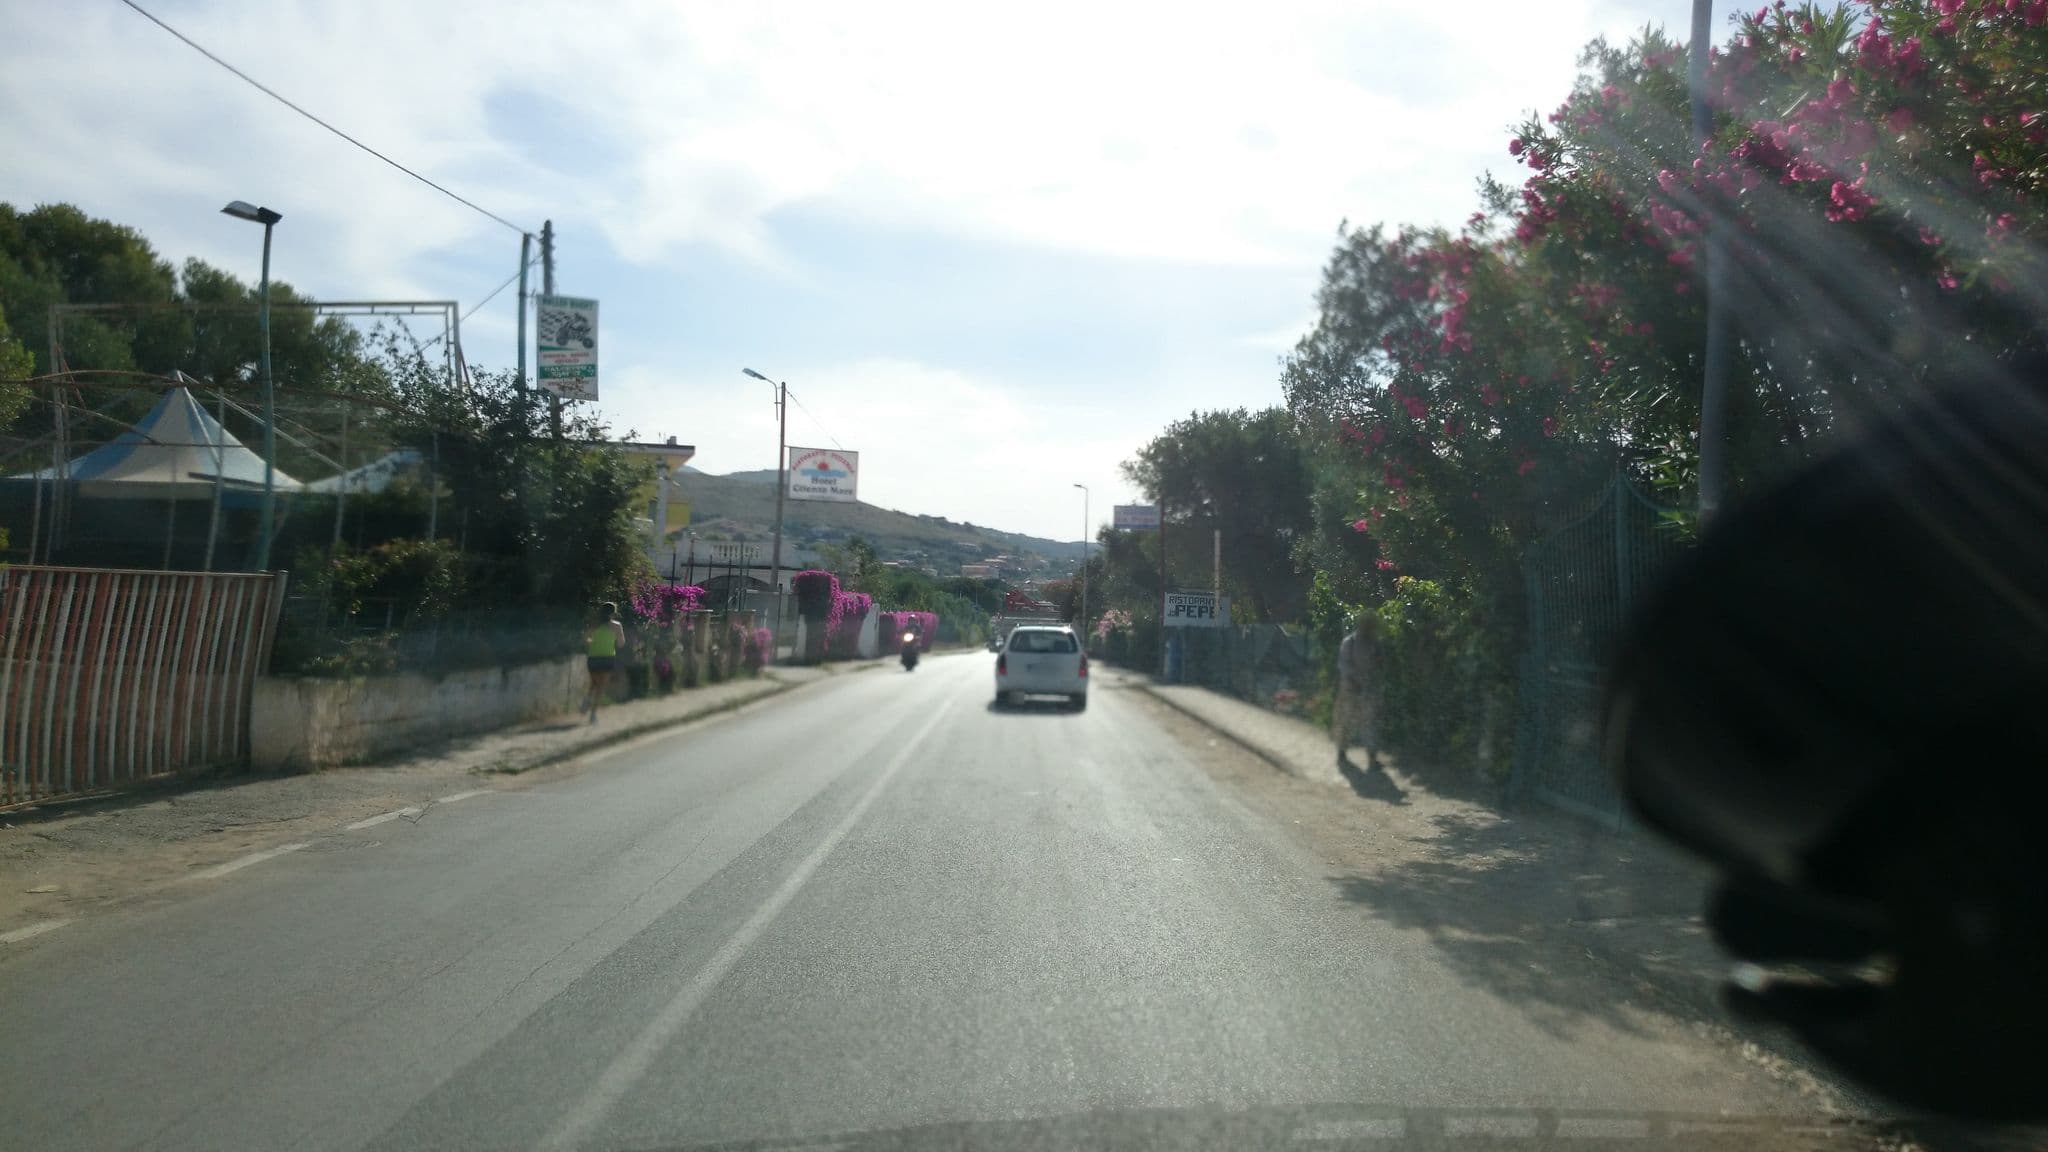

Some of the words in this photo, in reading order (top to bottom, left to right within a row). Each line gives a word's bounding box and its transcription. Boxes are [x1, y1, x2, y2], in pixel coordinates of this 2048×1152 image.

[811, 477, 837, 485] Hotel
[830, 486, 853, 495] Mare
[1169, 595, 1220, 606] RISTORANT
